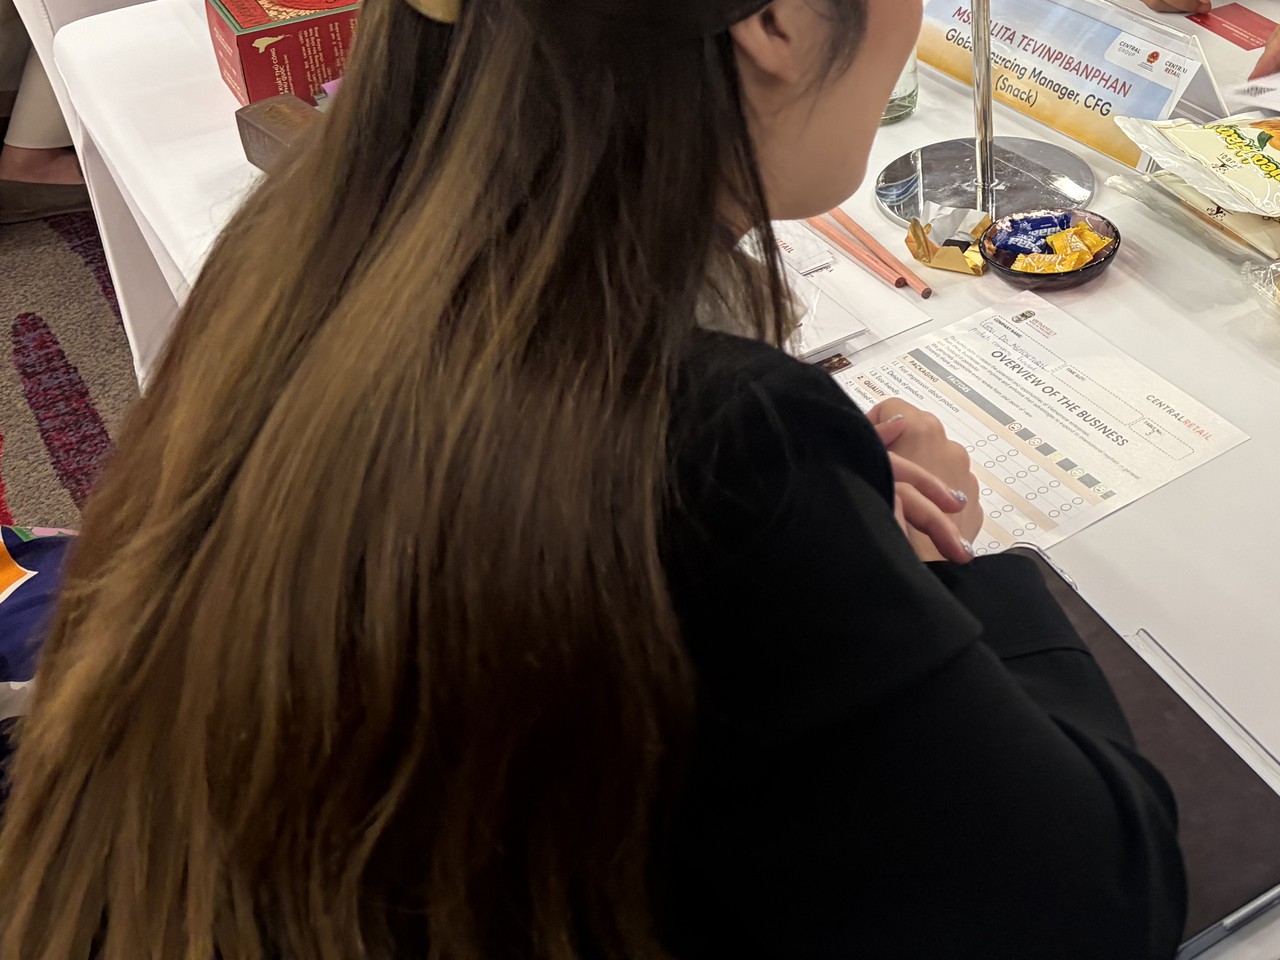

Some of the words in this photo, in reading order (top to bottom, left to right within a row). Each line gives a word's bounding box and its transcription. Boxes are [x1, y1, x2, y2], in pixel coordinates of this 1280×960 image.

[952, 6, 972, 25] MS.
[988, 21, 1017, 45] LITA
[1018, 33, 1133, 97] TEVINPIBANPHAN
[1117, 47, 1136, 57] GROUP
[1119, 41, 1140, 54] CENTRAL
[945, 28, 974, 52] Glob
[990, 51, 1026, 80] ourcing
[1028, 71, 1080, 105] Manager,
[1084, 94, 1113, 117] CFG
[1163, 67, 1181, 78] RETAIL
[995, 74, 1038, 108] (Snack)
[908, 358, 938, 383] PACKAGING
[863, 378, 886, 398] QUALITY
[946, 373, 971, 393] FACTORS
[990, 348, 1044, 389] OVERVIEW
[1041, 383, 1059, 399] OF
[1056, 393, 1080, 414] THE
[1075, 407, 1129, 448] BUSINESS
